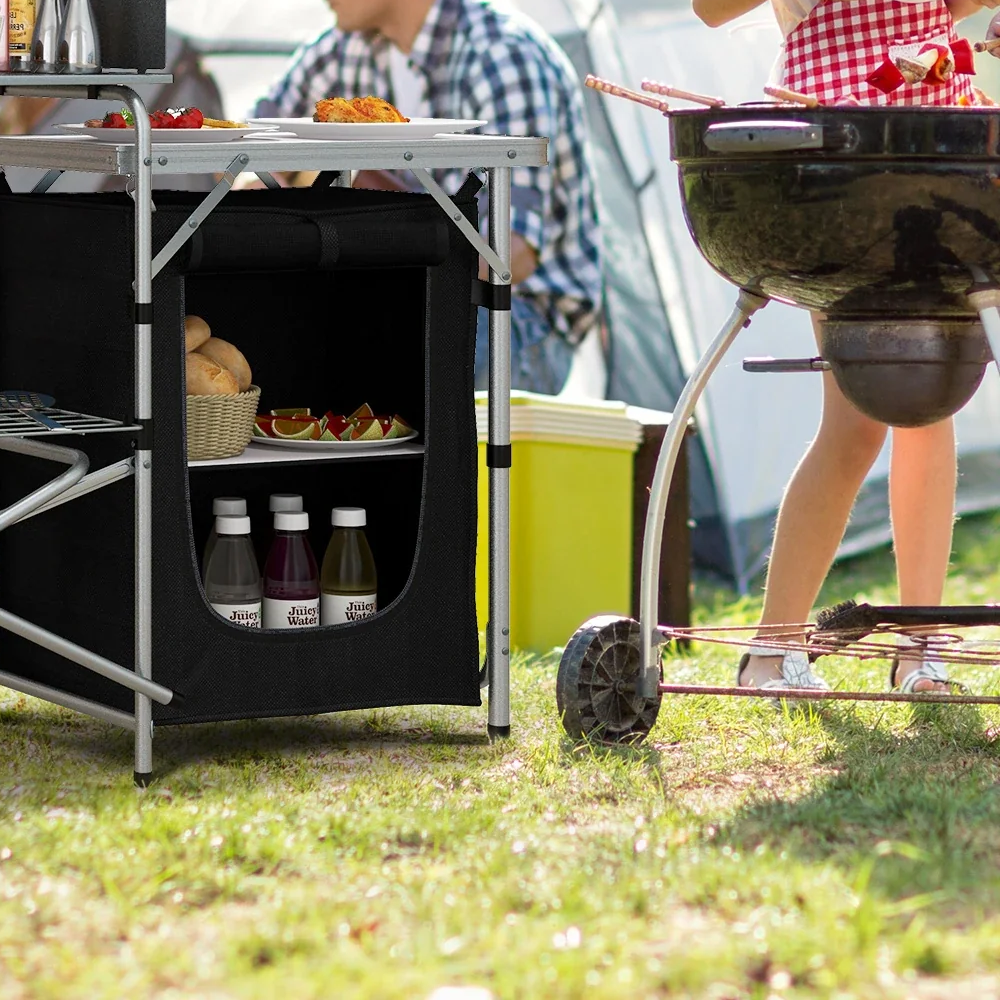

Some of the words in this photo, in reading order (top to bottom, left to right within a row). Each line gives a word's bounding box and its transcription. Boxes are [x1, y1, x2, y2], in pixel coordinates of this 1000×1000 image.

[289, 606, 317, 617] Juicy
[345, 601, 374, 612] Juicy
[230, 610, 258, 621] Juicy
[287, 616, 318, 626] Water
